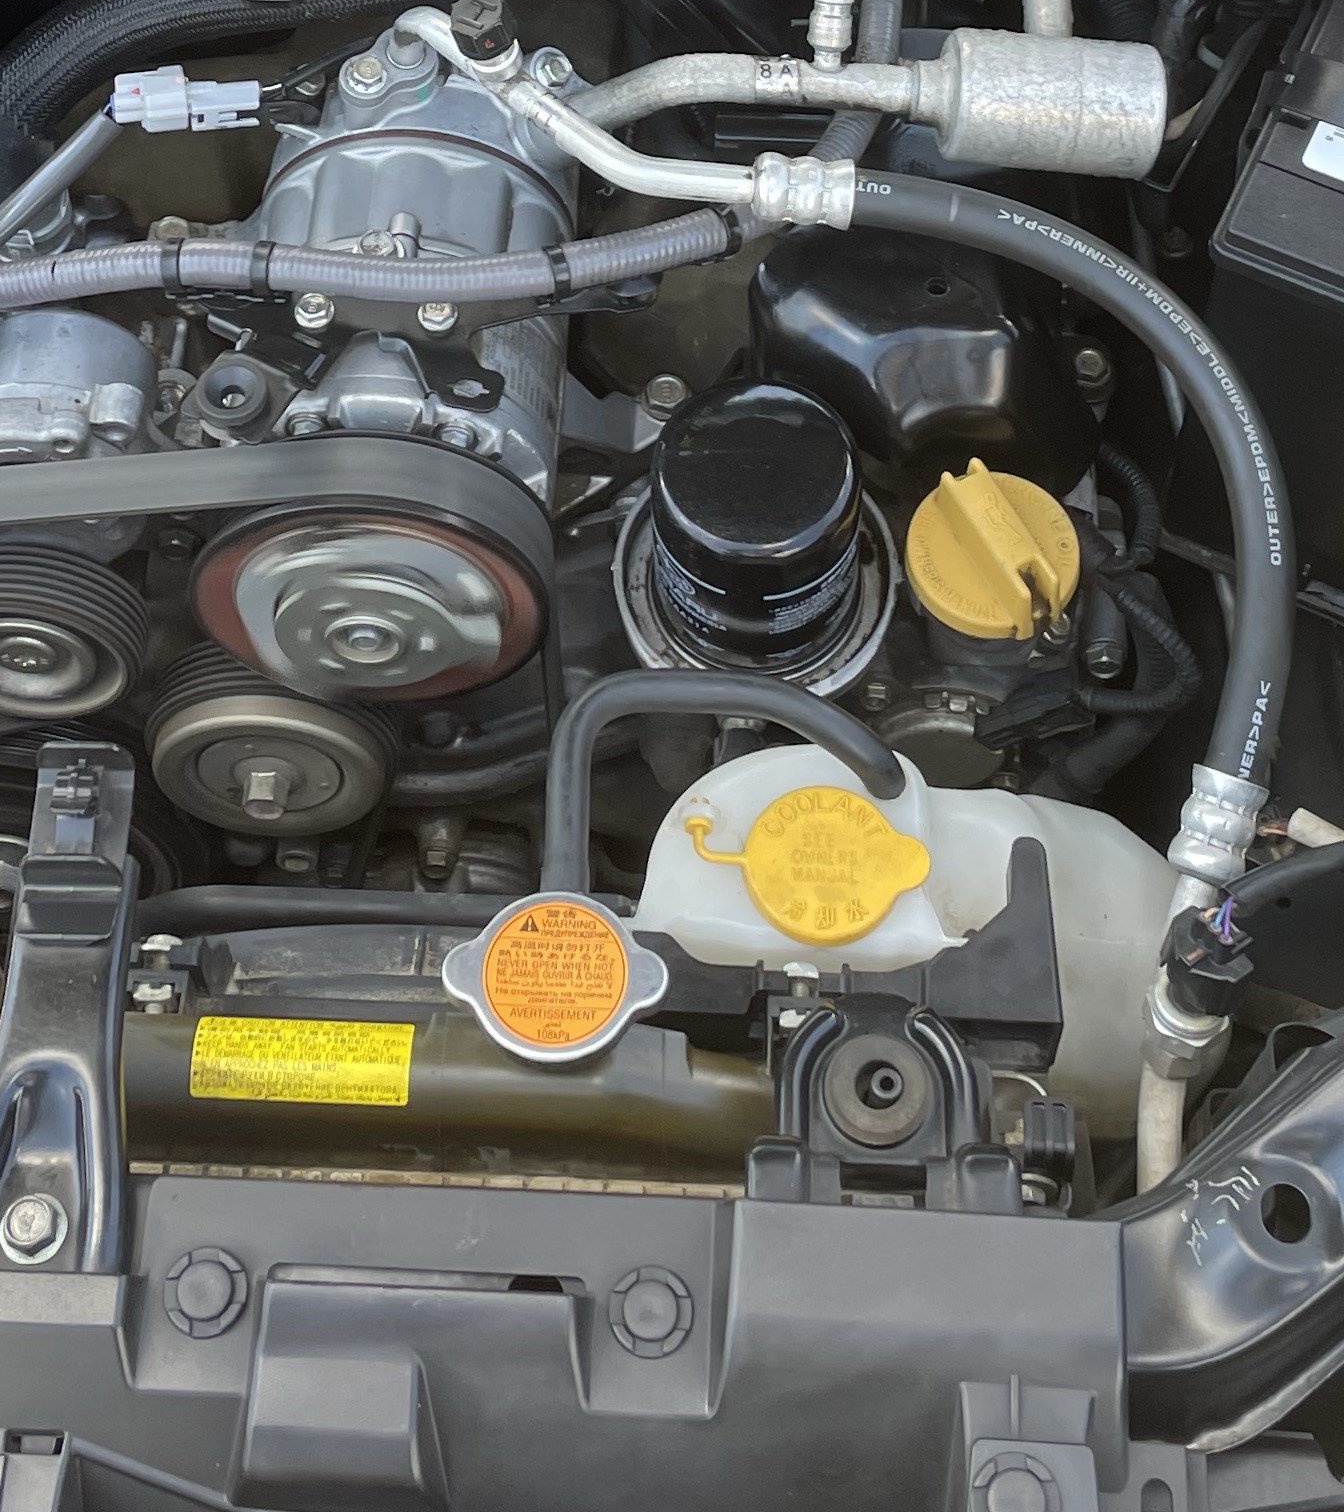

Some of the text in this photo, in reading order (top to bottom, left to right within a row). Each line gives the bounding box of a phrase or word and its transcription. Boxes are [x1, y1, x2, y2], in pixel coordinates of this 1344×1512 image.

[760, 64, 793, 78] 8 A
[761, 792, 888, 837] COOLANT
[542, 918, 596, 929] WARNING
[496, 958, 528, 968] NEVER
[532, 960, 557, 969] OPEN
[561, 961, 590, 969] WHEN
[509, 1007, 595, 1020] AVERTISSEMENT
